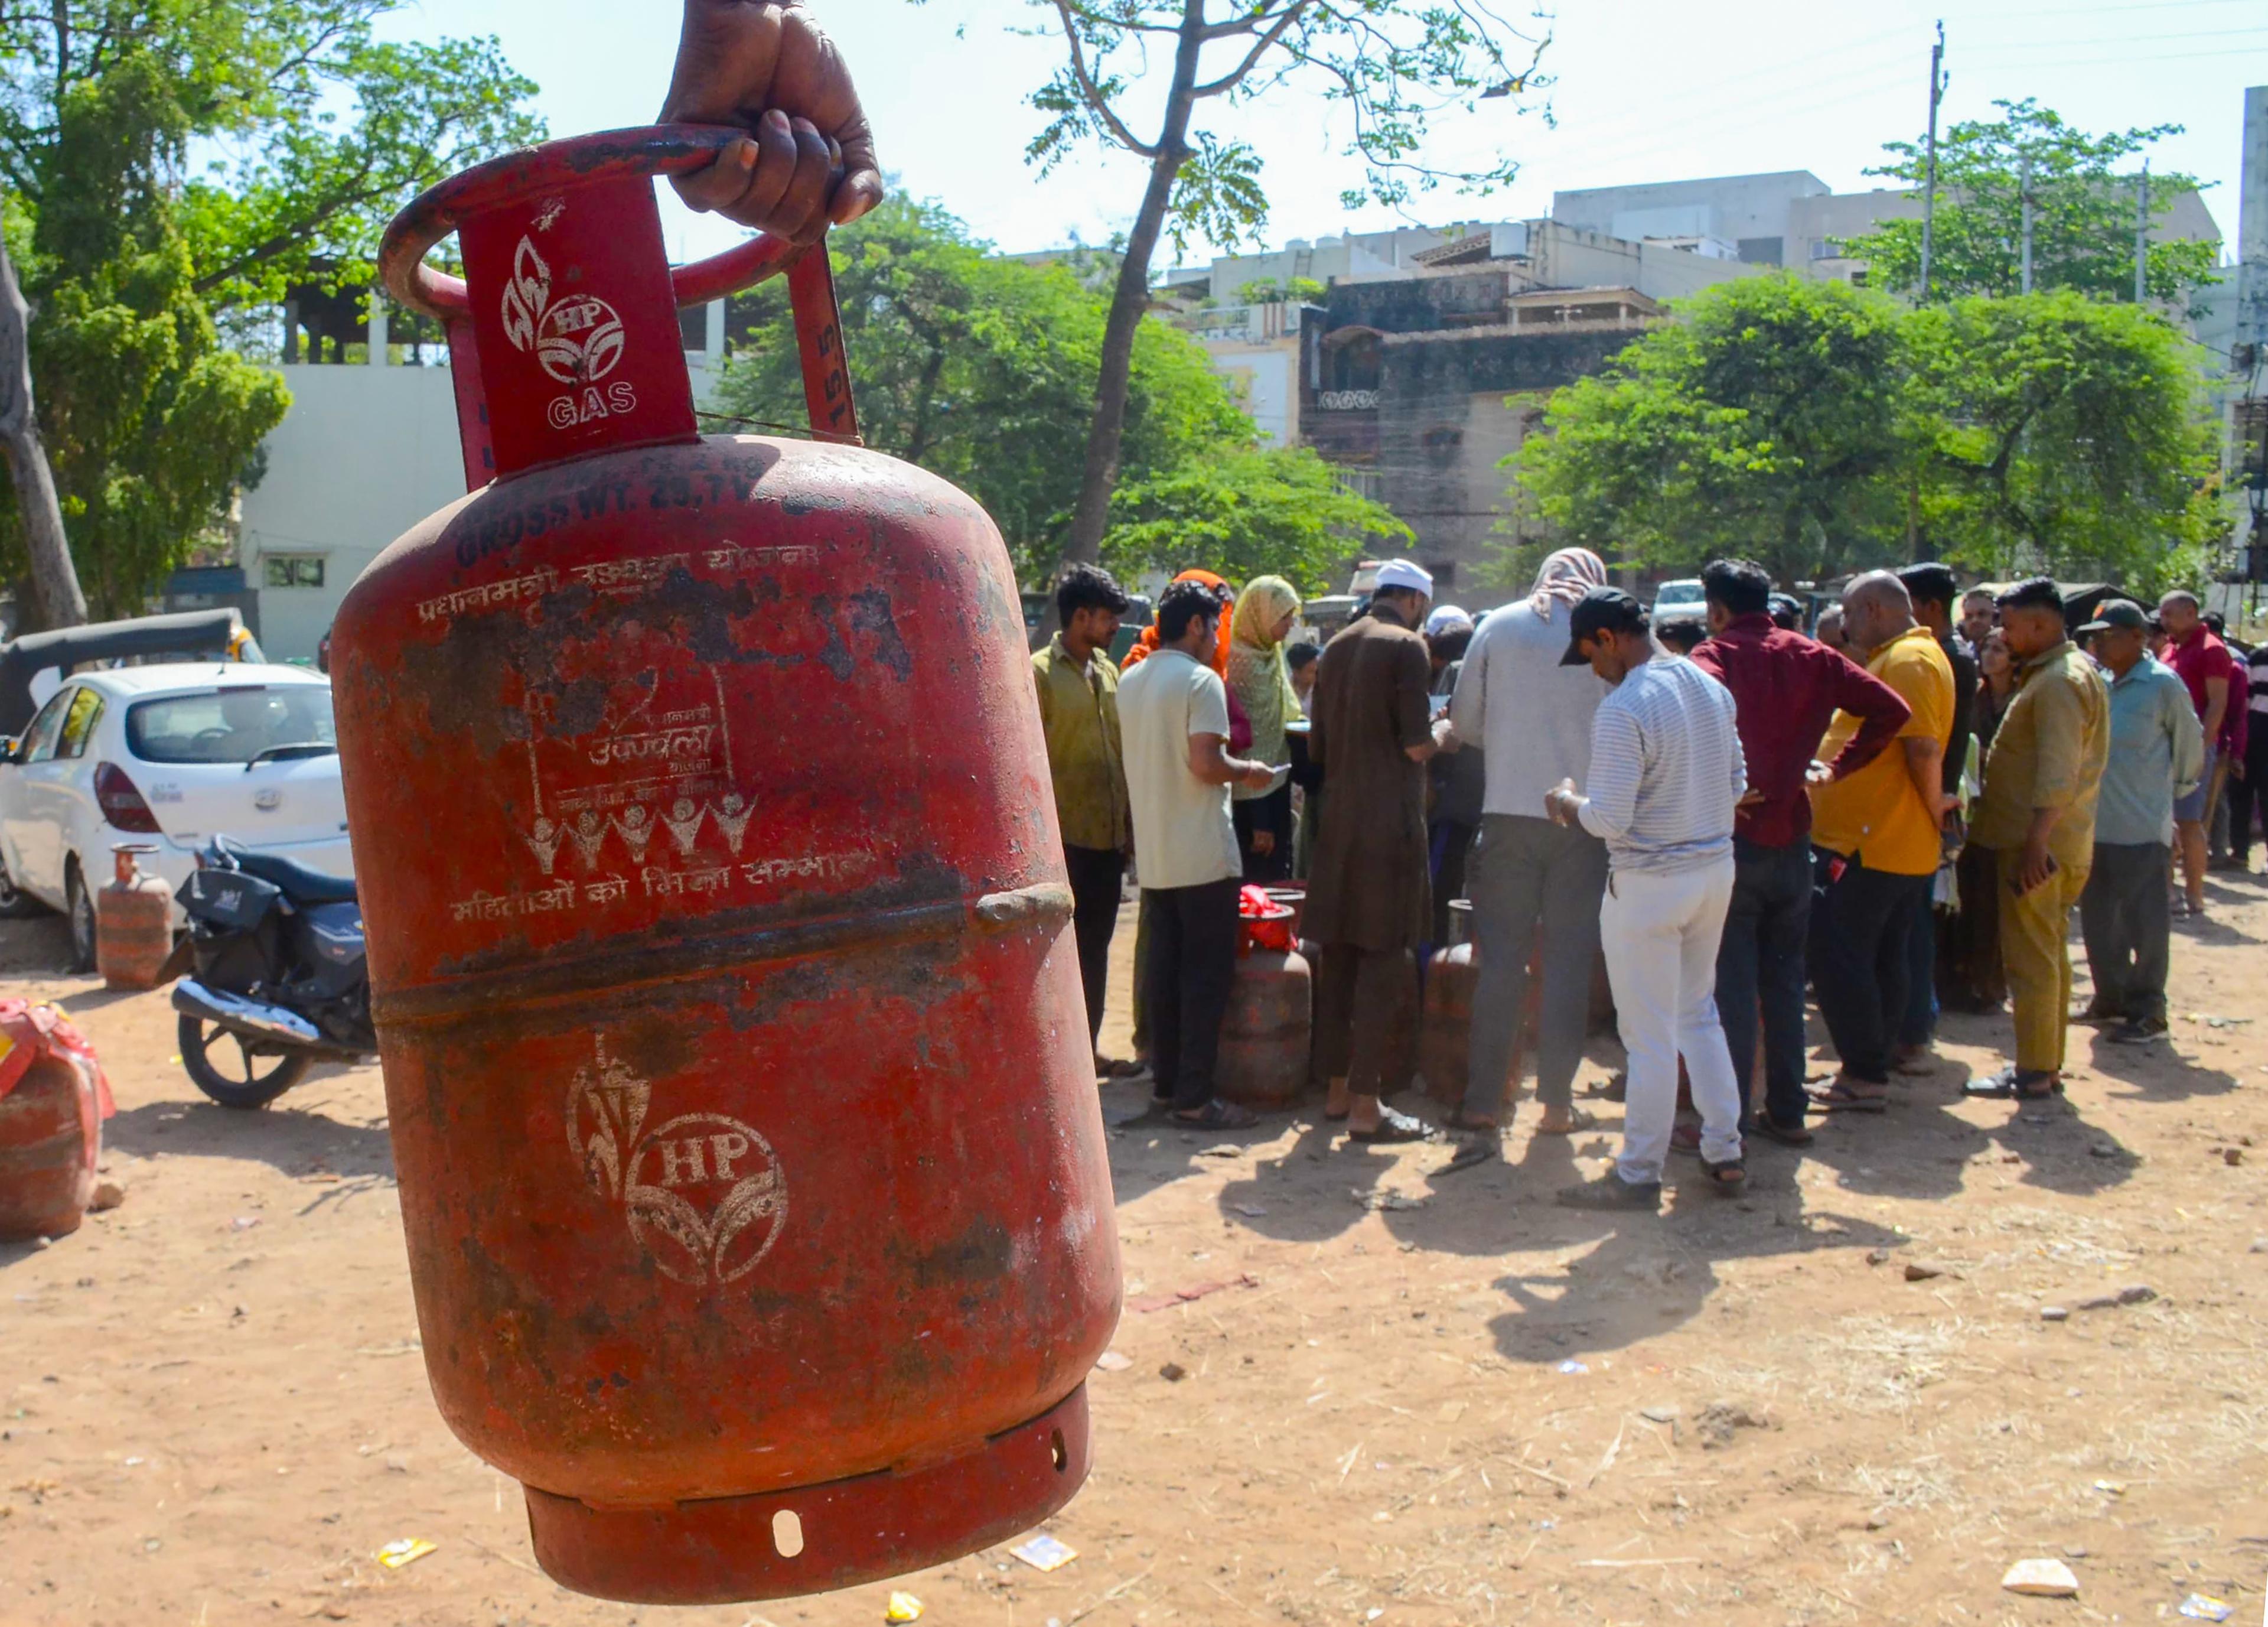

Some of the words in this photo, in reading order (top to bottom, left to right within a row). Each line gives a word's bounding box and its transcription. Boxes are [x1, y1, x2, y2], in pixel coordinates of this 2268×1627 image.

[553, 302, 601, 336] HP
[548, 382, 637, 429] GAS
[584, 871, 630, 904] को
[659, 1133, 749, 1187] HP
